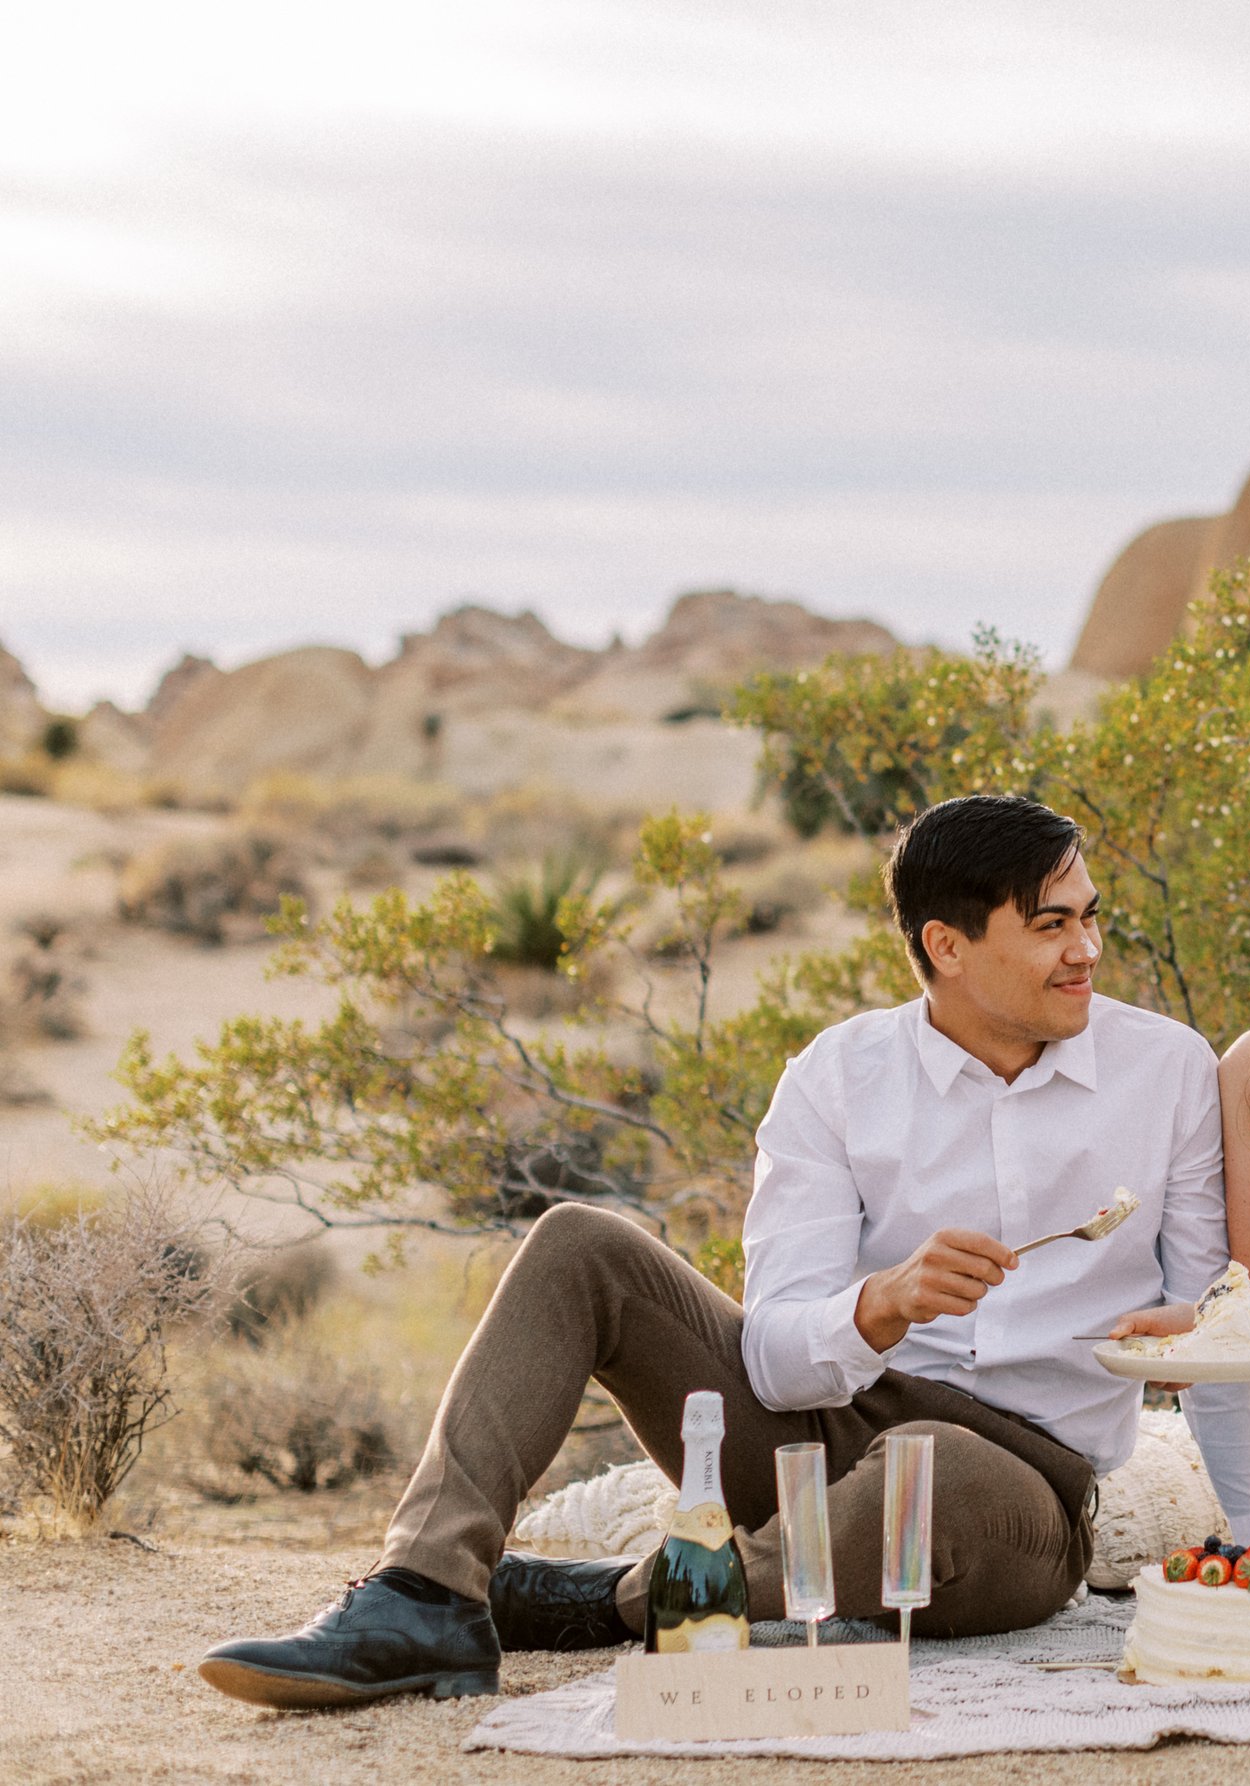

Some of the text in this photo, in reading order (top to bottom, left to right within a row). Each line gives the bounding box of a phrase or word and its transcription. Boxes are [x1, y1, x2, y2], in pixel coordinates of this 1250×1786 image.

[704, 1450, 713, 1490] KORBEL
[660, 1684, 870, 1705] WE ELOPED
